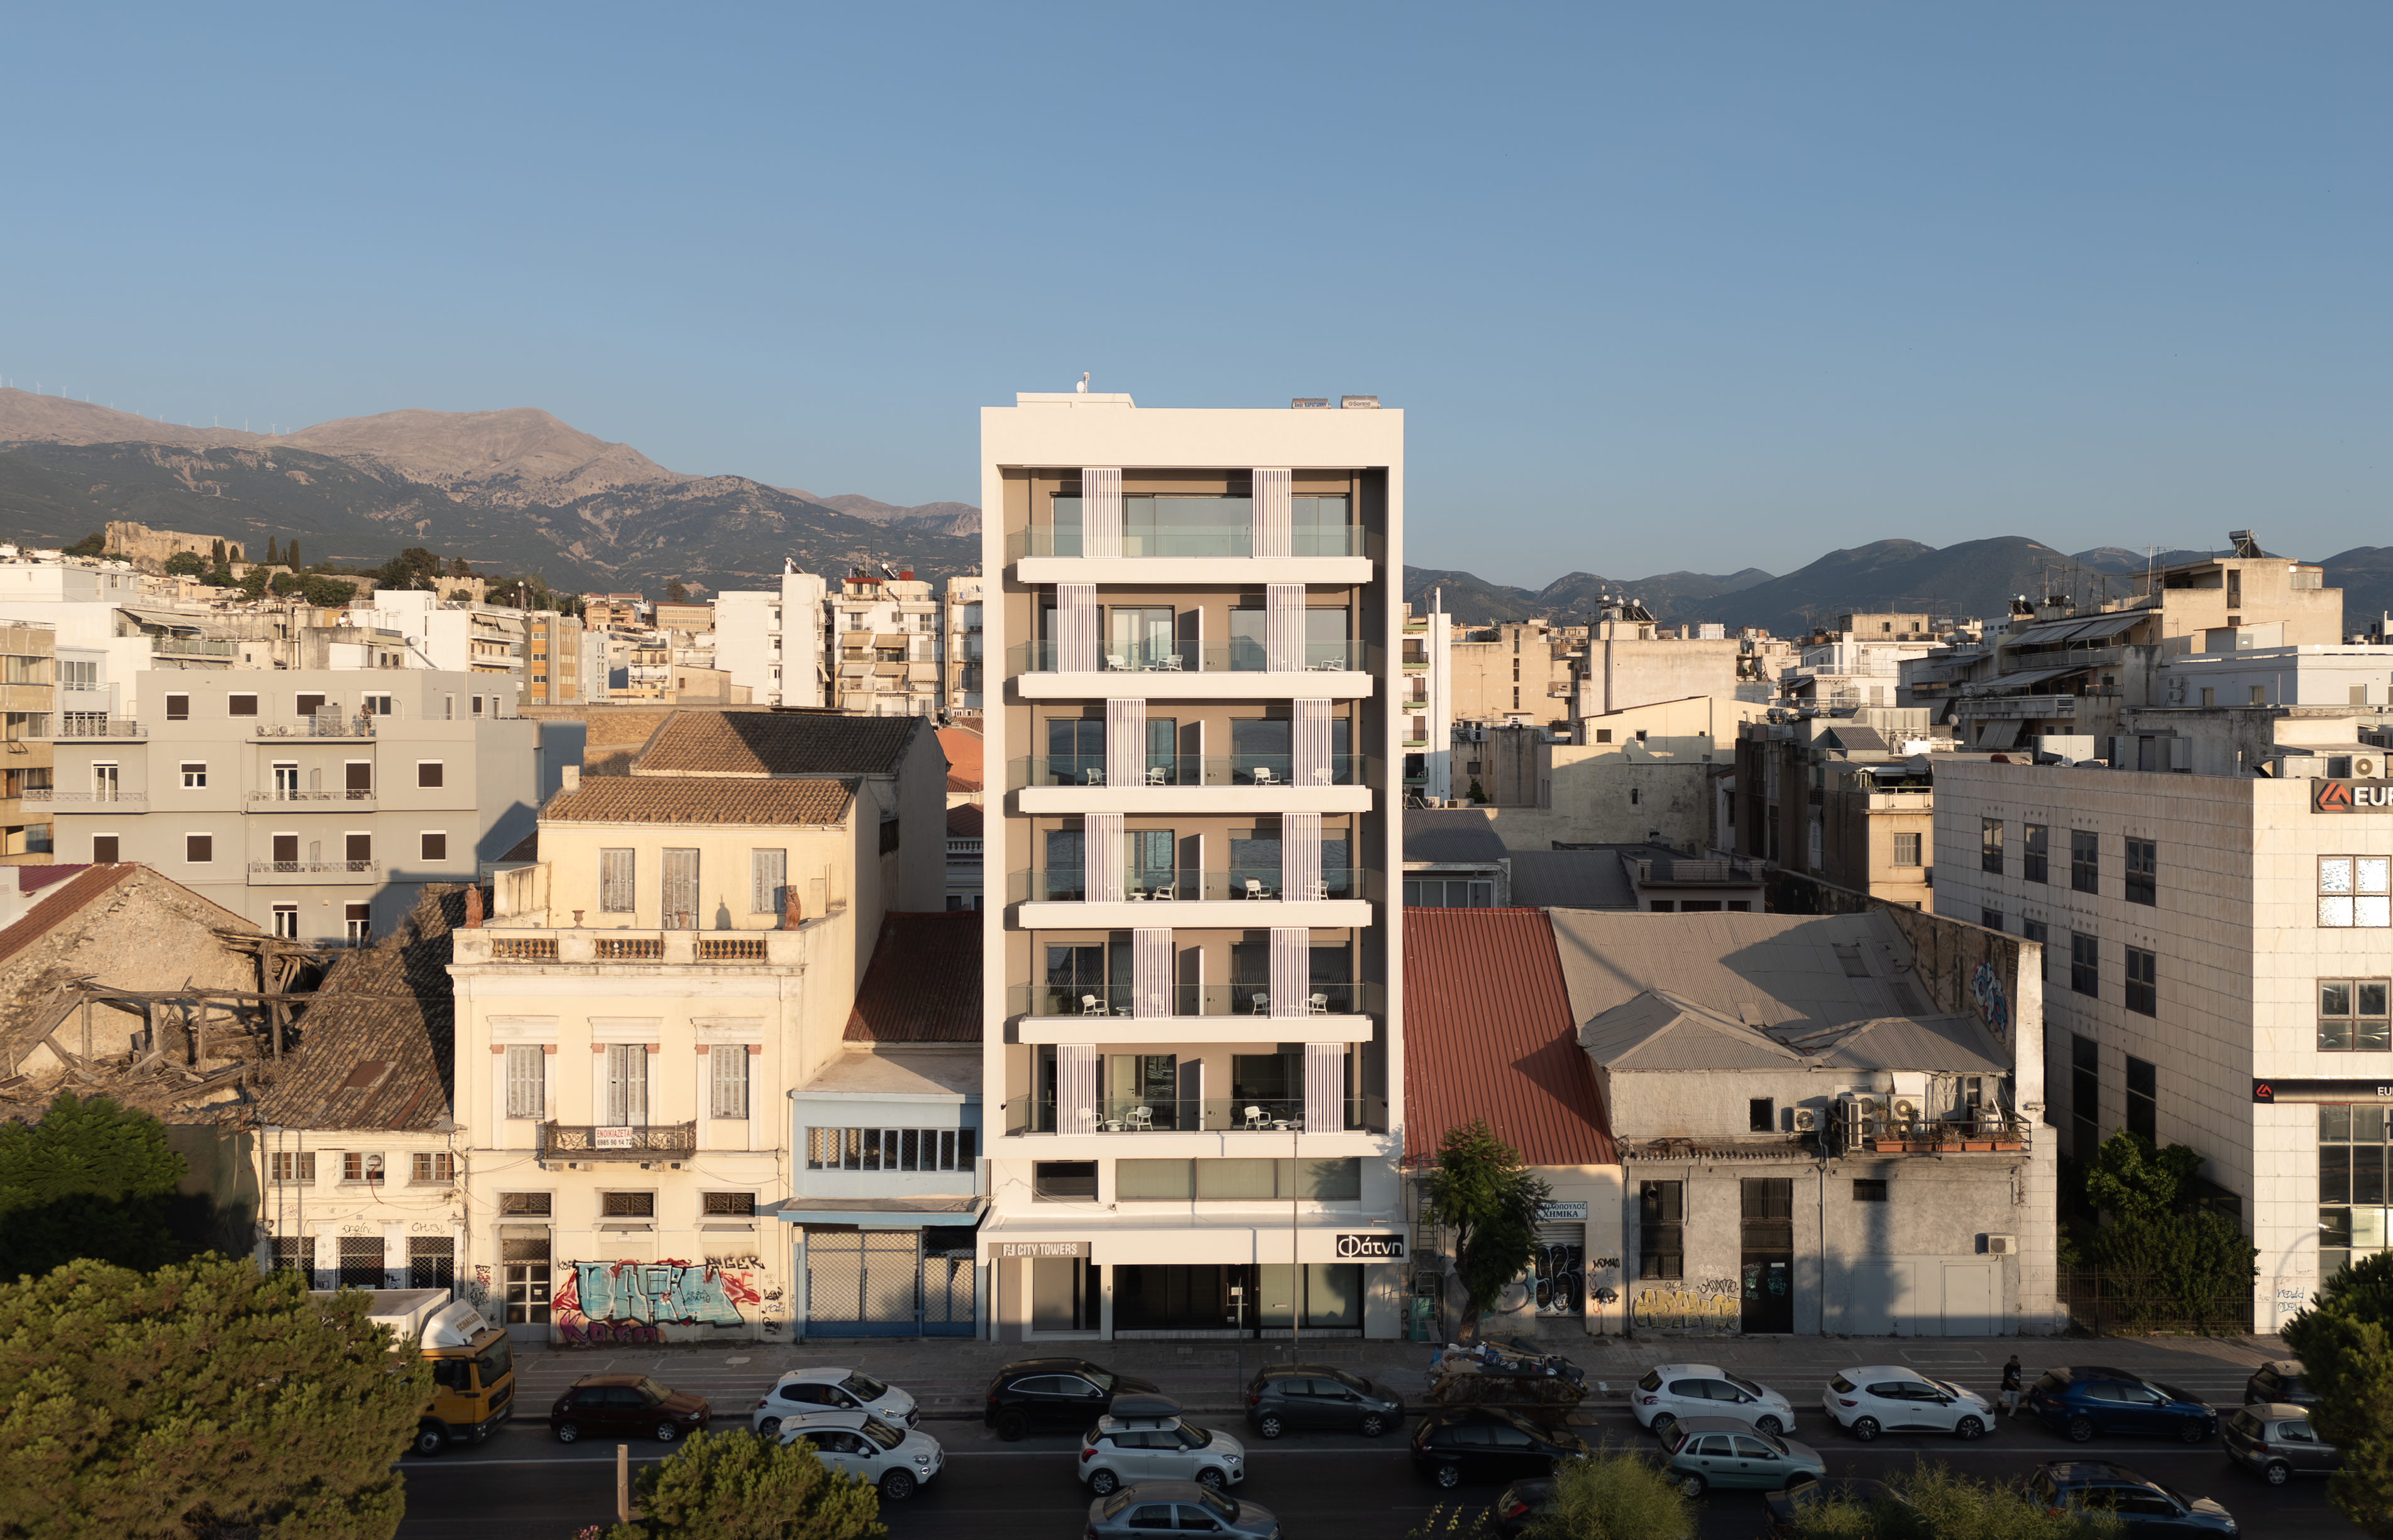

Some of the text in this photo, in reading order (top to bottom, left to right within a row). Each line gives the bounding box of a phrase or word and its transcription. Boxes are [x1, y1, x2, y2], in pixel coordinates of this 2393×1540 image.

[2377, 1087, 2393, 1096] EU
[597, 1129, 632, 1138] ΕΝΟΙΚΙΑΖΕΤΑΙ
[1017, 1243, 1037, 1256] CITY
[1039, 1243, 1077, 1255] TOWERS
[1338, 1235, 1403, 1258] Φάτνη
